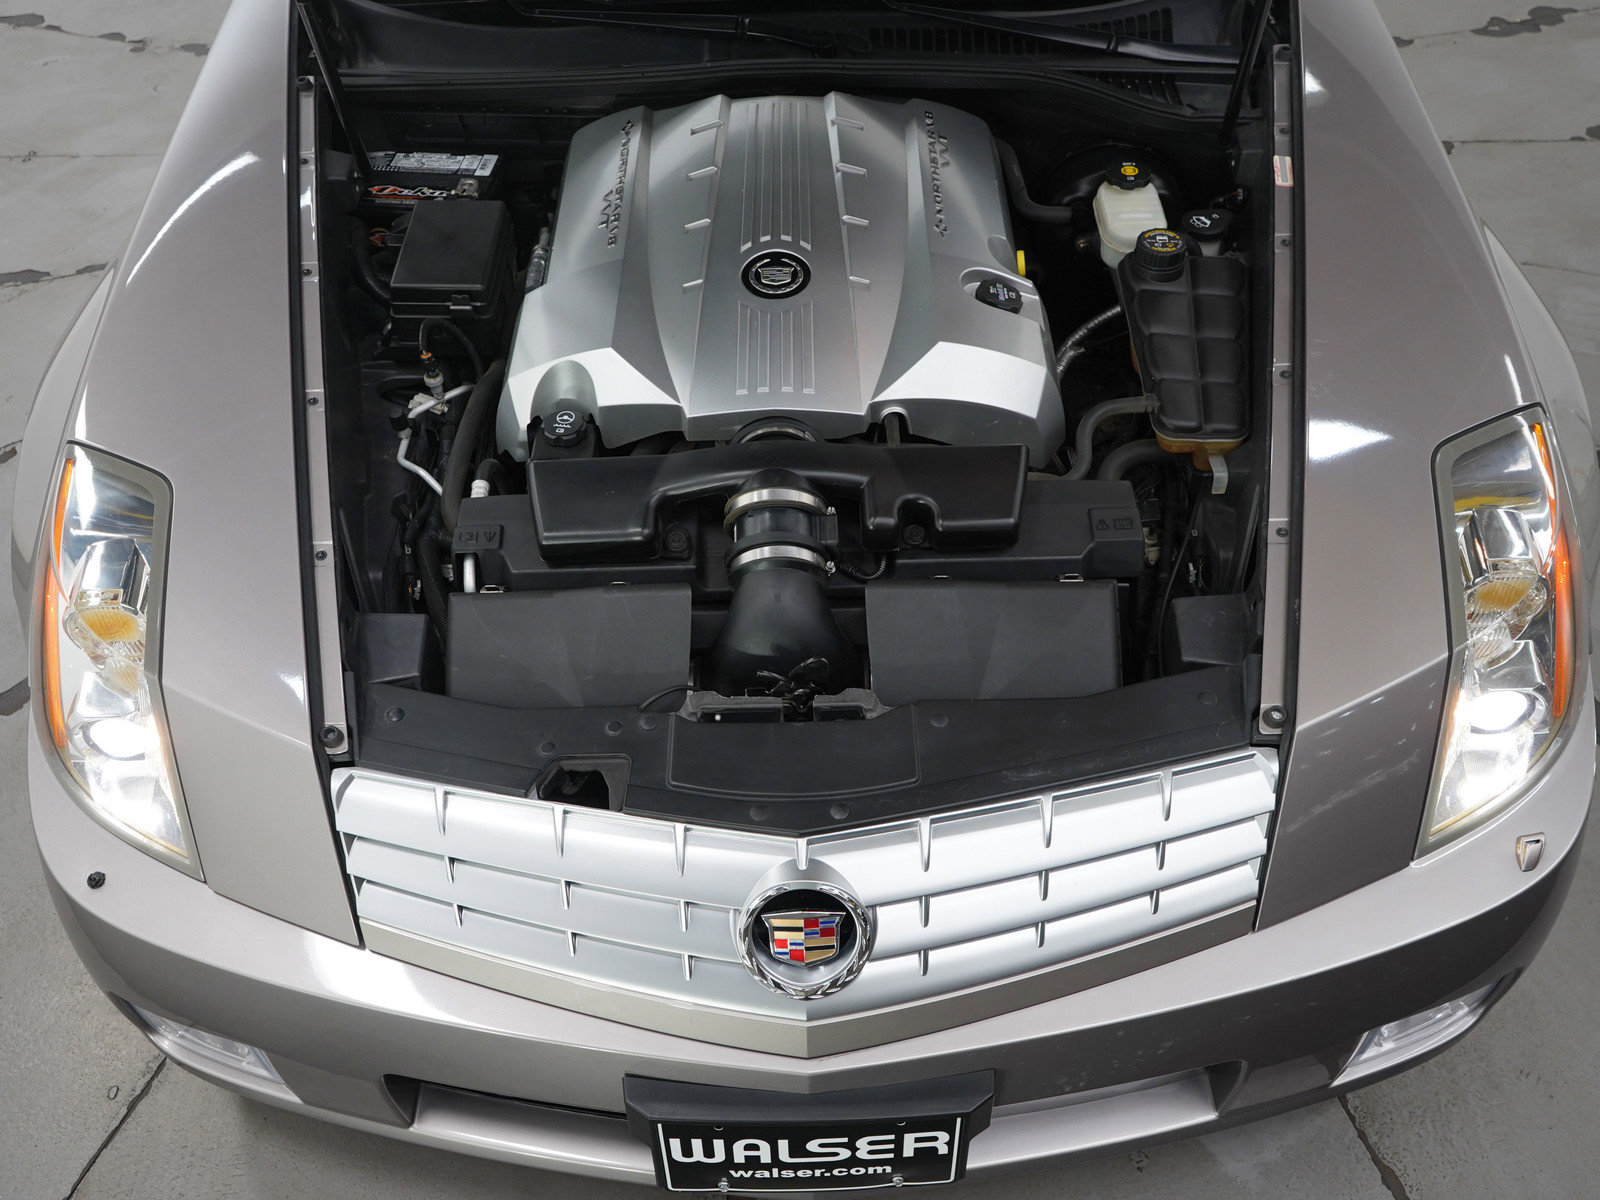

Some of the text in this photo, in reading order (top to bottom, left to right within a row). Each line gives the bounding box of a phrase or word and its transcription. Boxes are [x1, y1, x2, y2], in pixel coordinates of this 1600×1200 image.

[607, 138, 631, 249] NORTHSTAR V8
[924, 110, 946, 220] NORTHSTAR V8
[668, 1131, 951, 1164] WALSER
[729, 1164, 893, 1179] walser.com
